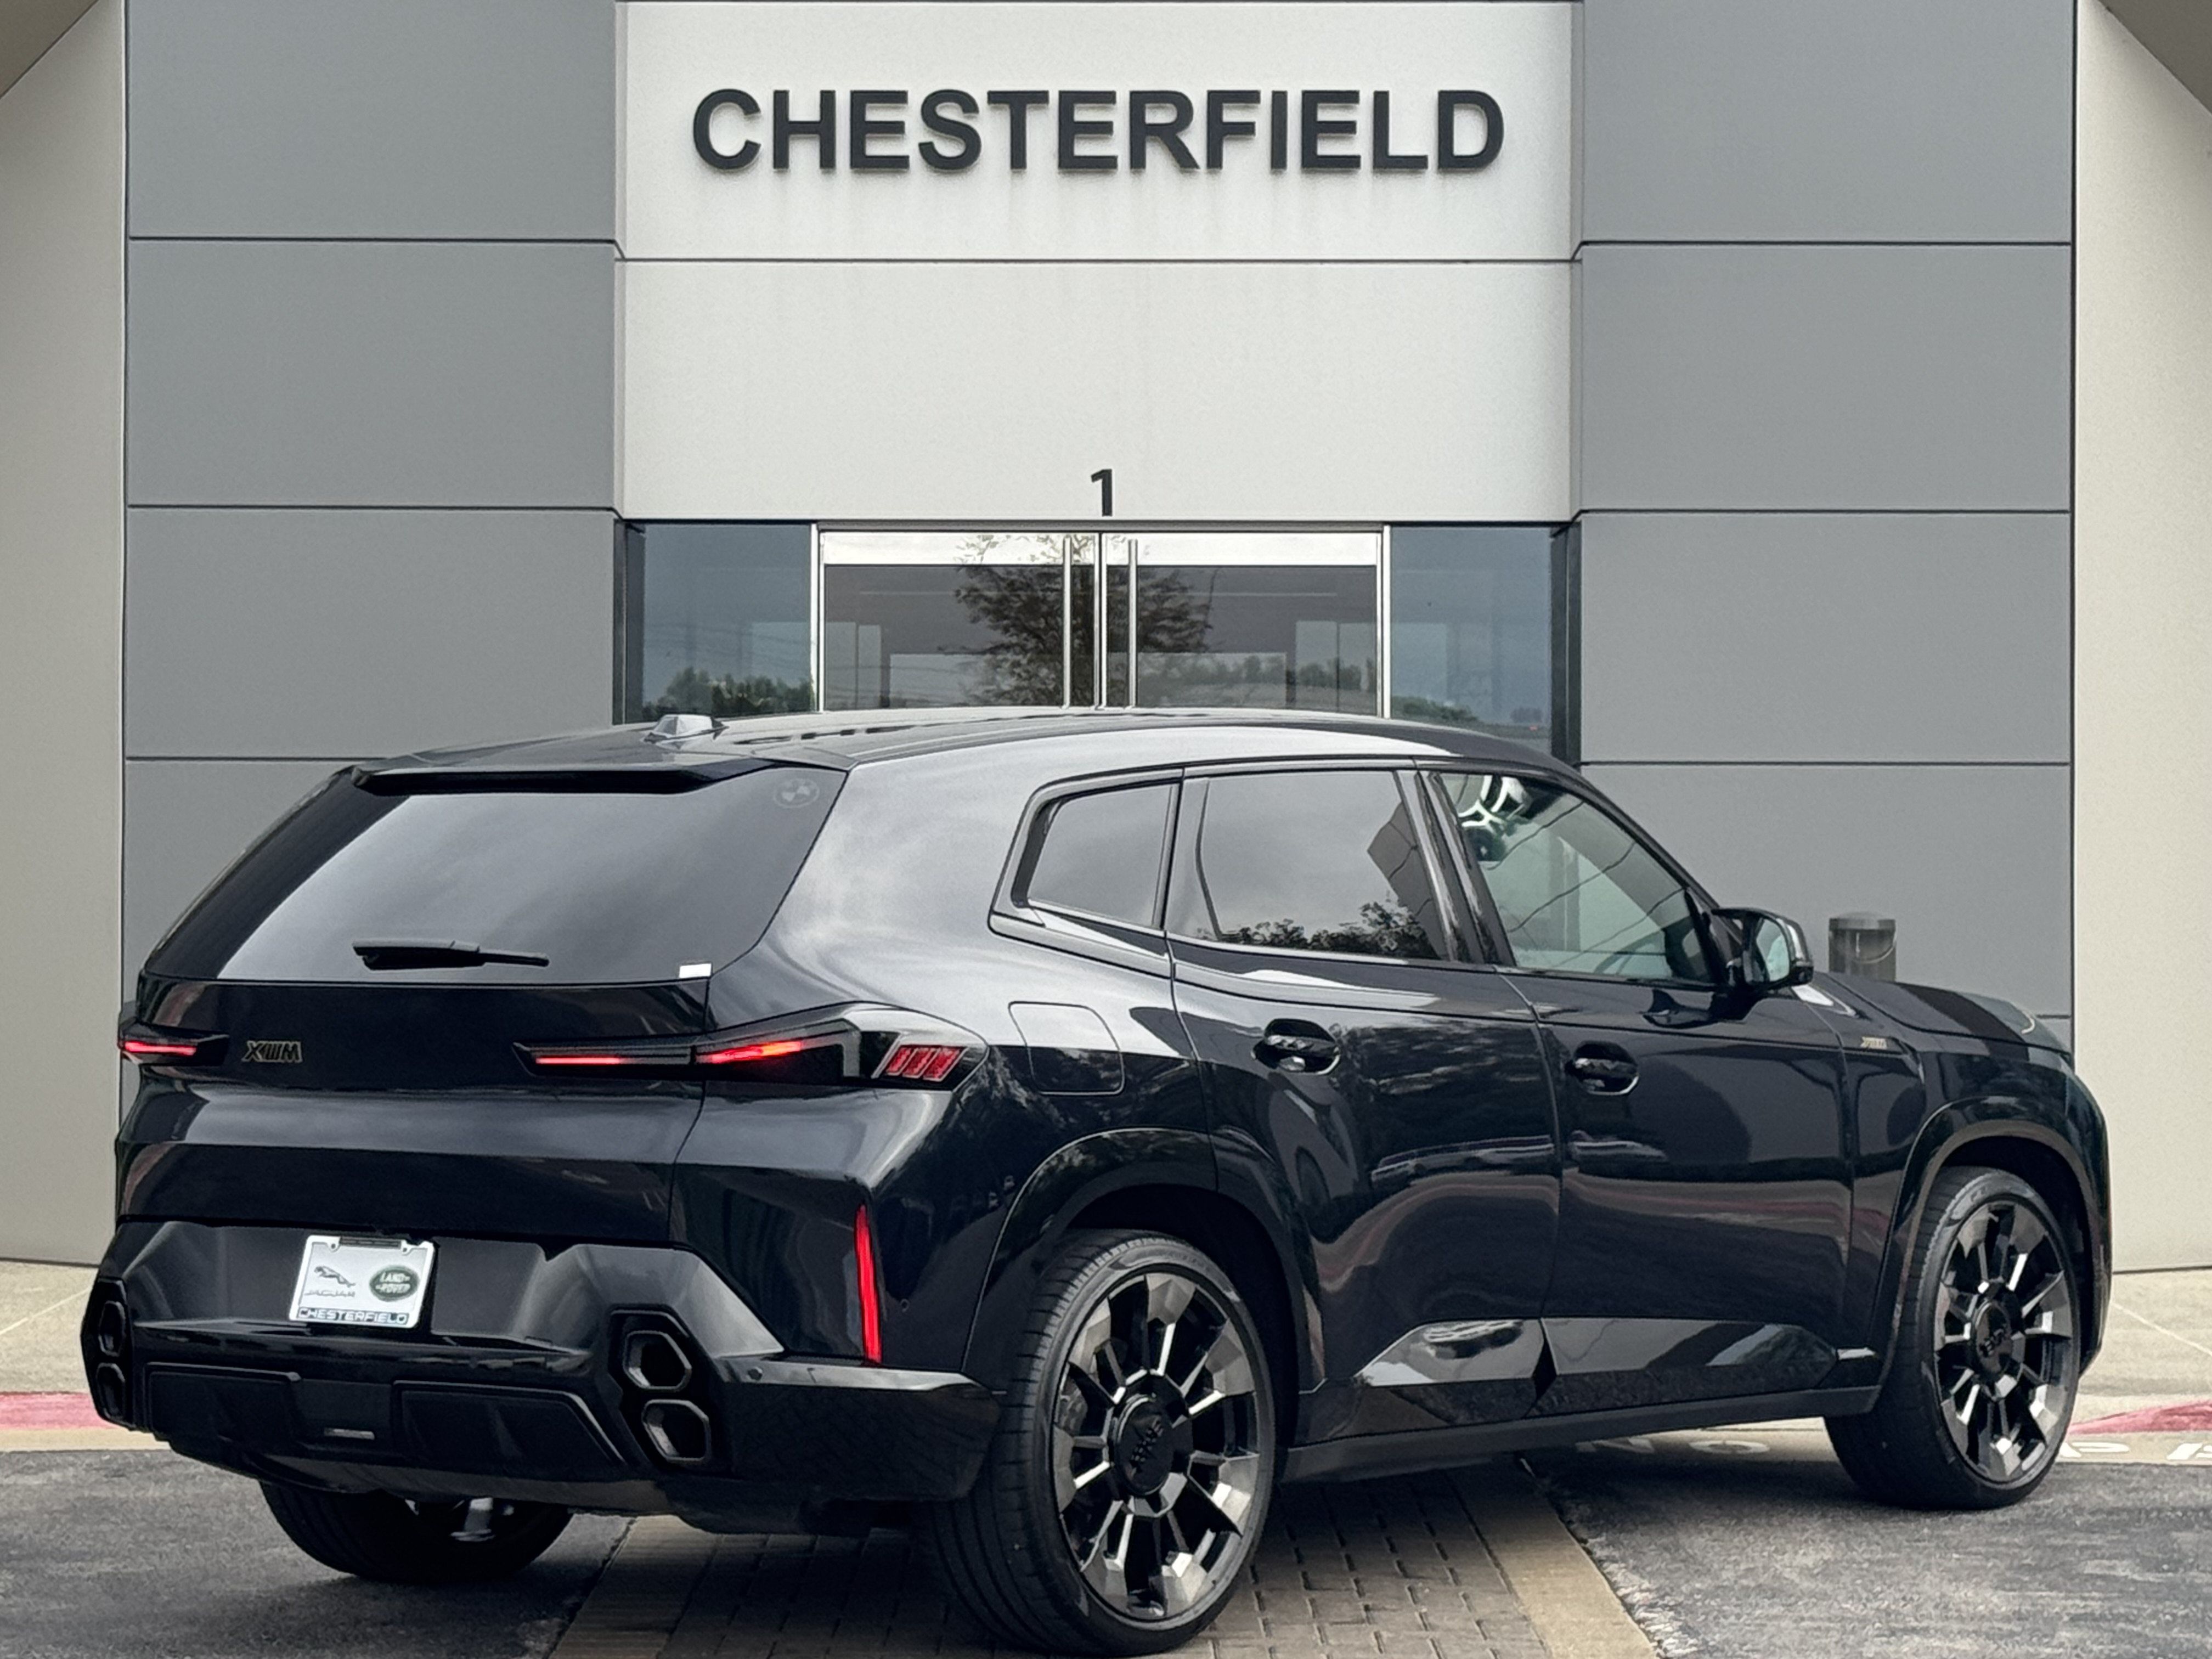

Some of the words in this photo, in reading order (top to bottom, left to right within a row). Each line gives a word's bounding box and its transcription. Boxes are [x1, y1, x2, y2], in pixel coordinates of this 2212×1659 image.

[693, 89, 1504, 173] CHESTERFIELD
[1091, 469, 1113, 517] 1
[298, 1308, 408, 1325] CHESTERFIELD
